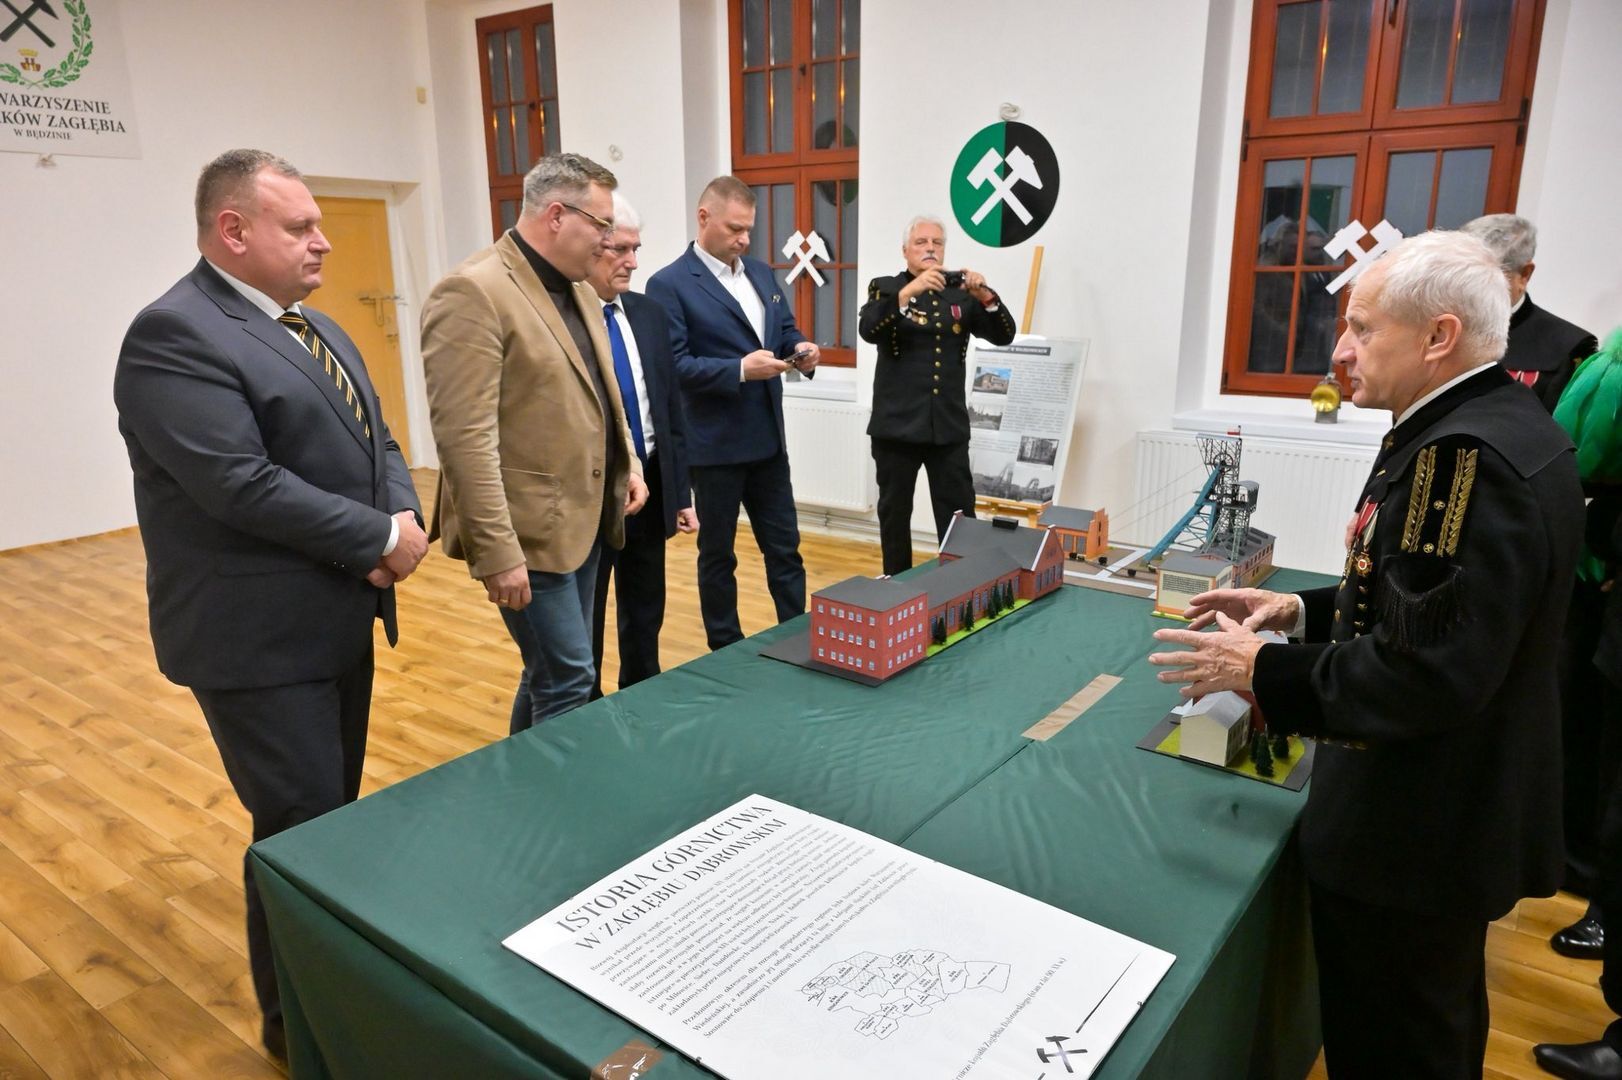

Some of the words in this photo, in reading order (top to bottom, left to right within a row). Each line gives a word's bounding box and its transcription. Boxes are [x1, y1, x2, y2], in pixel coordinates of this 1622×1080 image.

[14, 129, 23, 137] W
[26, 130, 72, 141] BĘDZINIE
[46, 114, 126, 134] ZAGŁĘBIA
[556, 873, 658, 933] ISTORIA
[652, 806, 773, 873] GÓRNICTWA
[575, 932, 601, 950] W
[598, 878, 687, 937] ZAGŁĘBIU
[682, 818, 788, 881] DĄBROWSKIM
